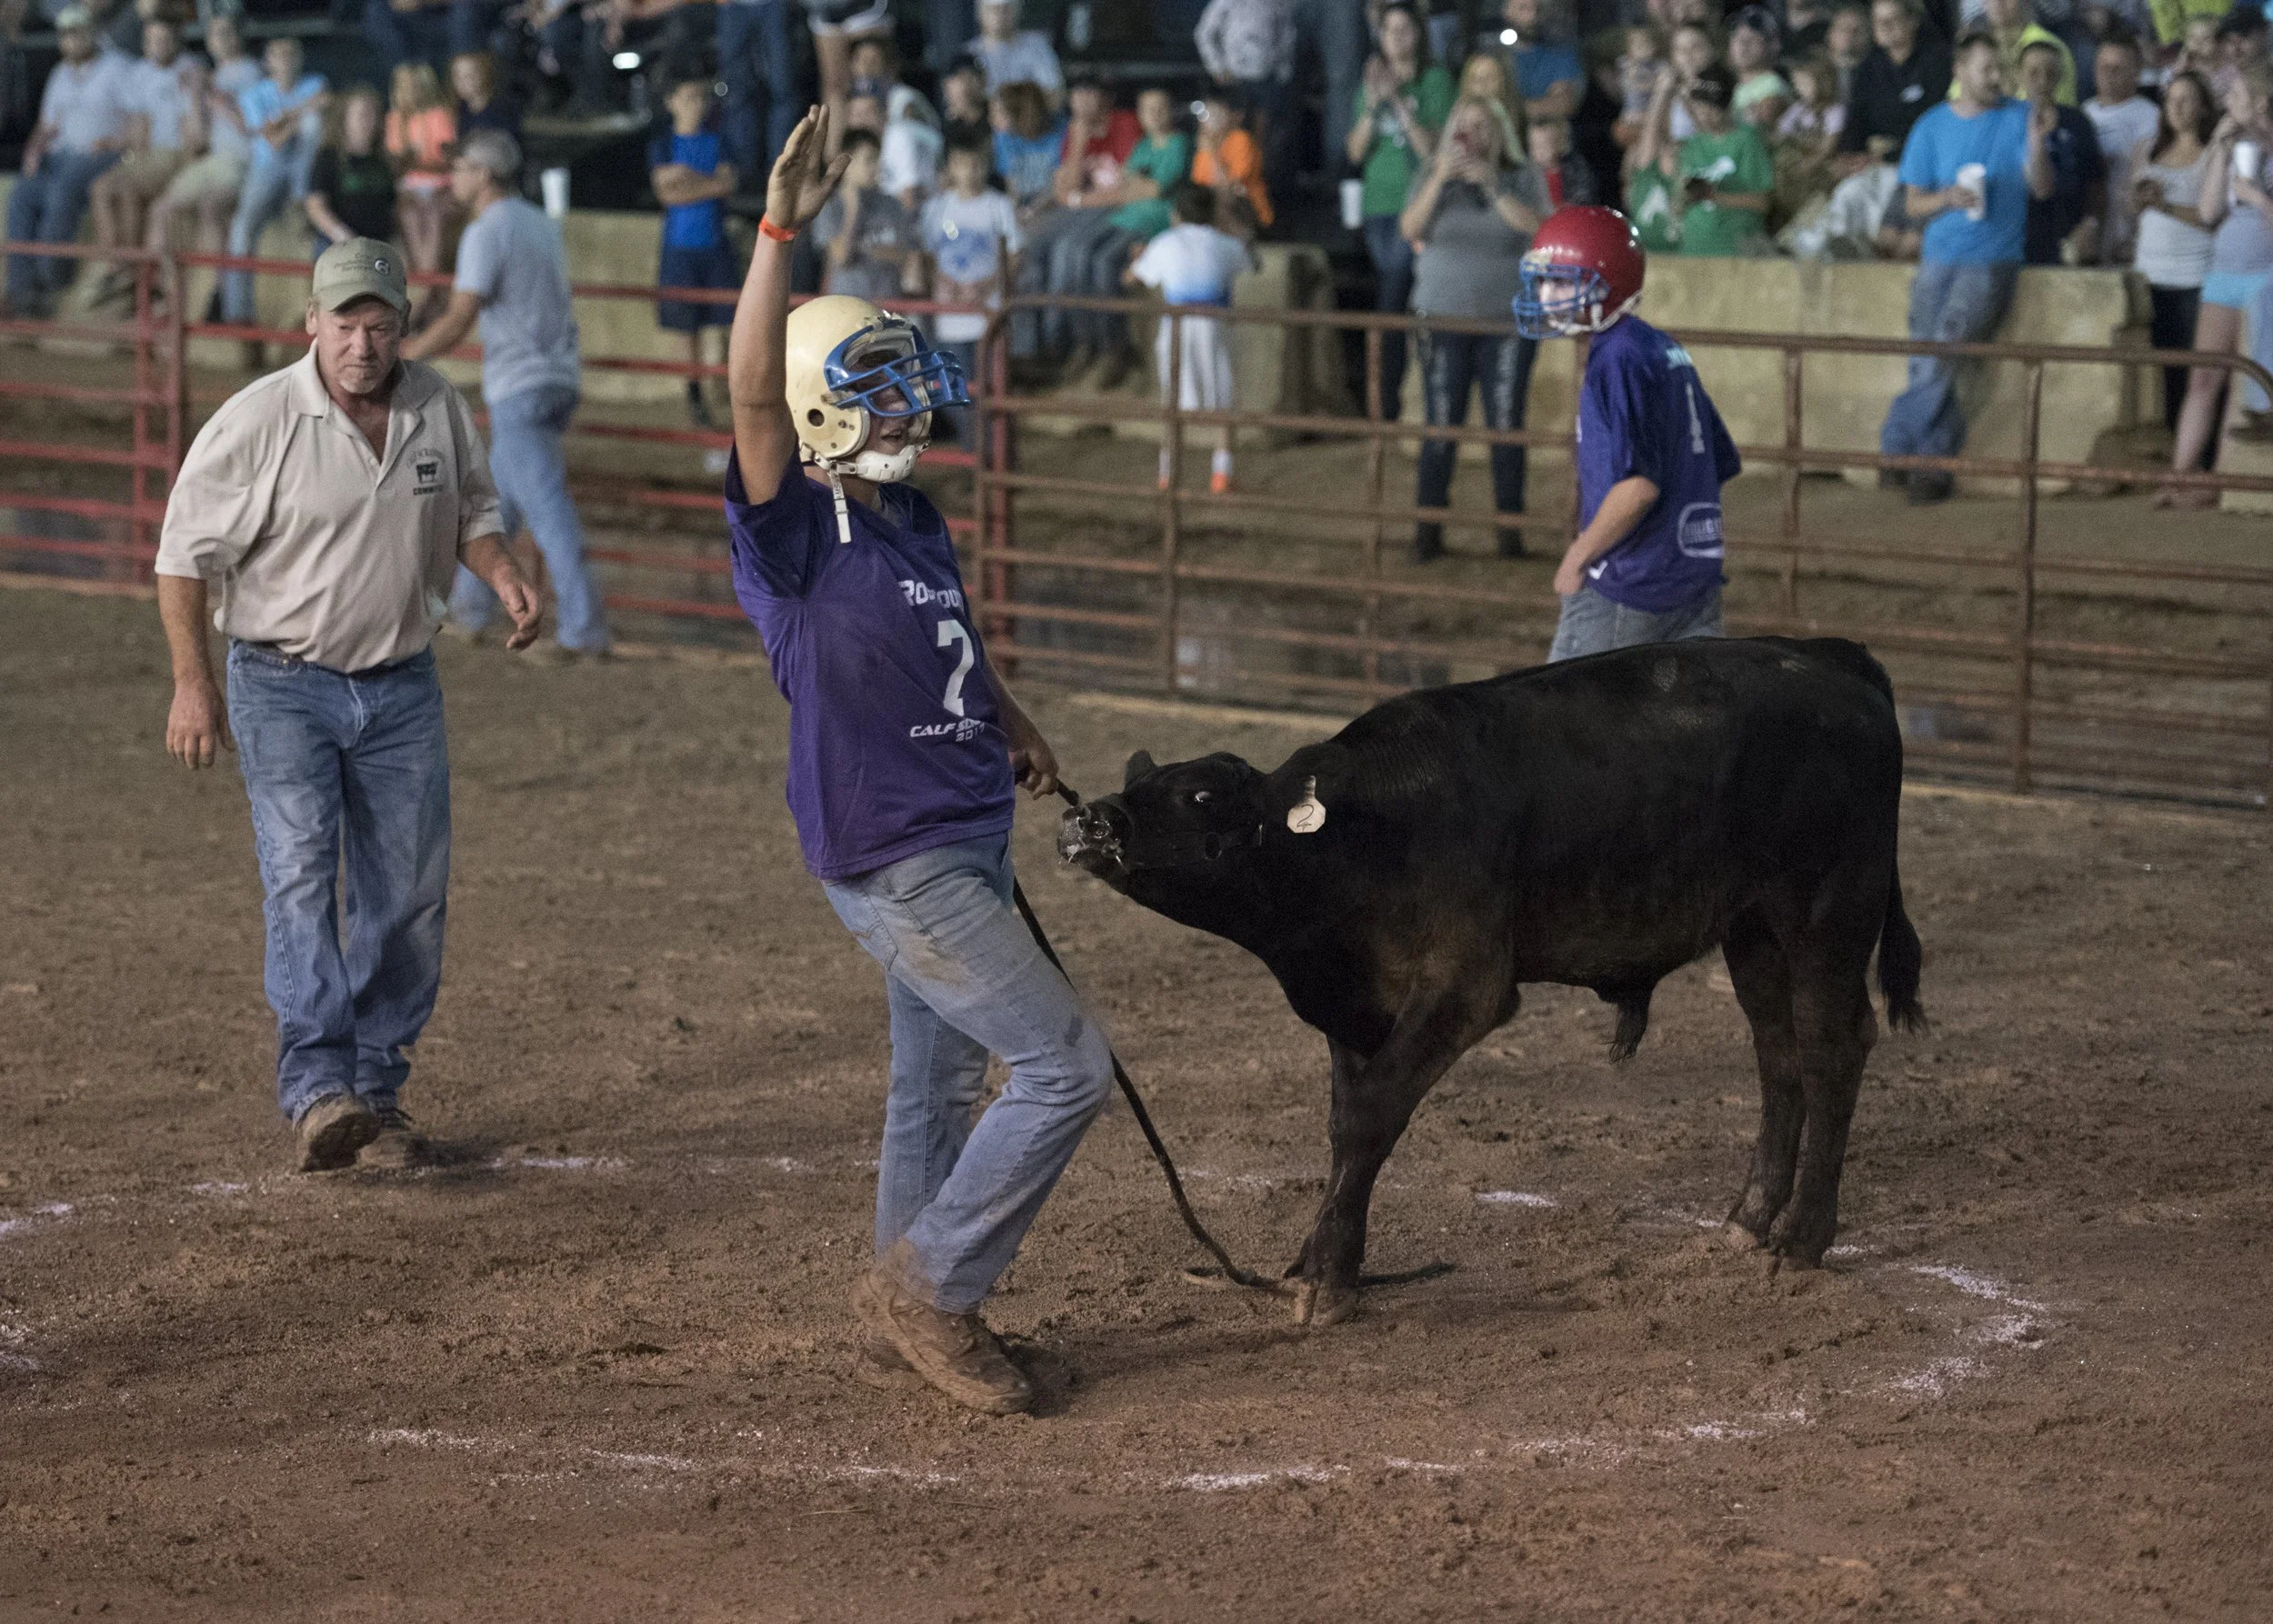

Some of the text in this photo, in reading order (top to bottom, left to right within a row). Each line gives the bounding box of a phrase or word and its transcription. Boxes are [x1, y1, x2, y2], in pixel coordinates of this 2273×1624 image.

[937, 619, 974, 717] 7
[910, 723, 956, 737] CALF
[1297, 803, 1314, 827] 2
